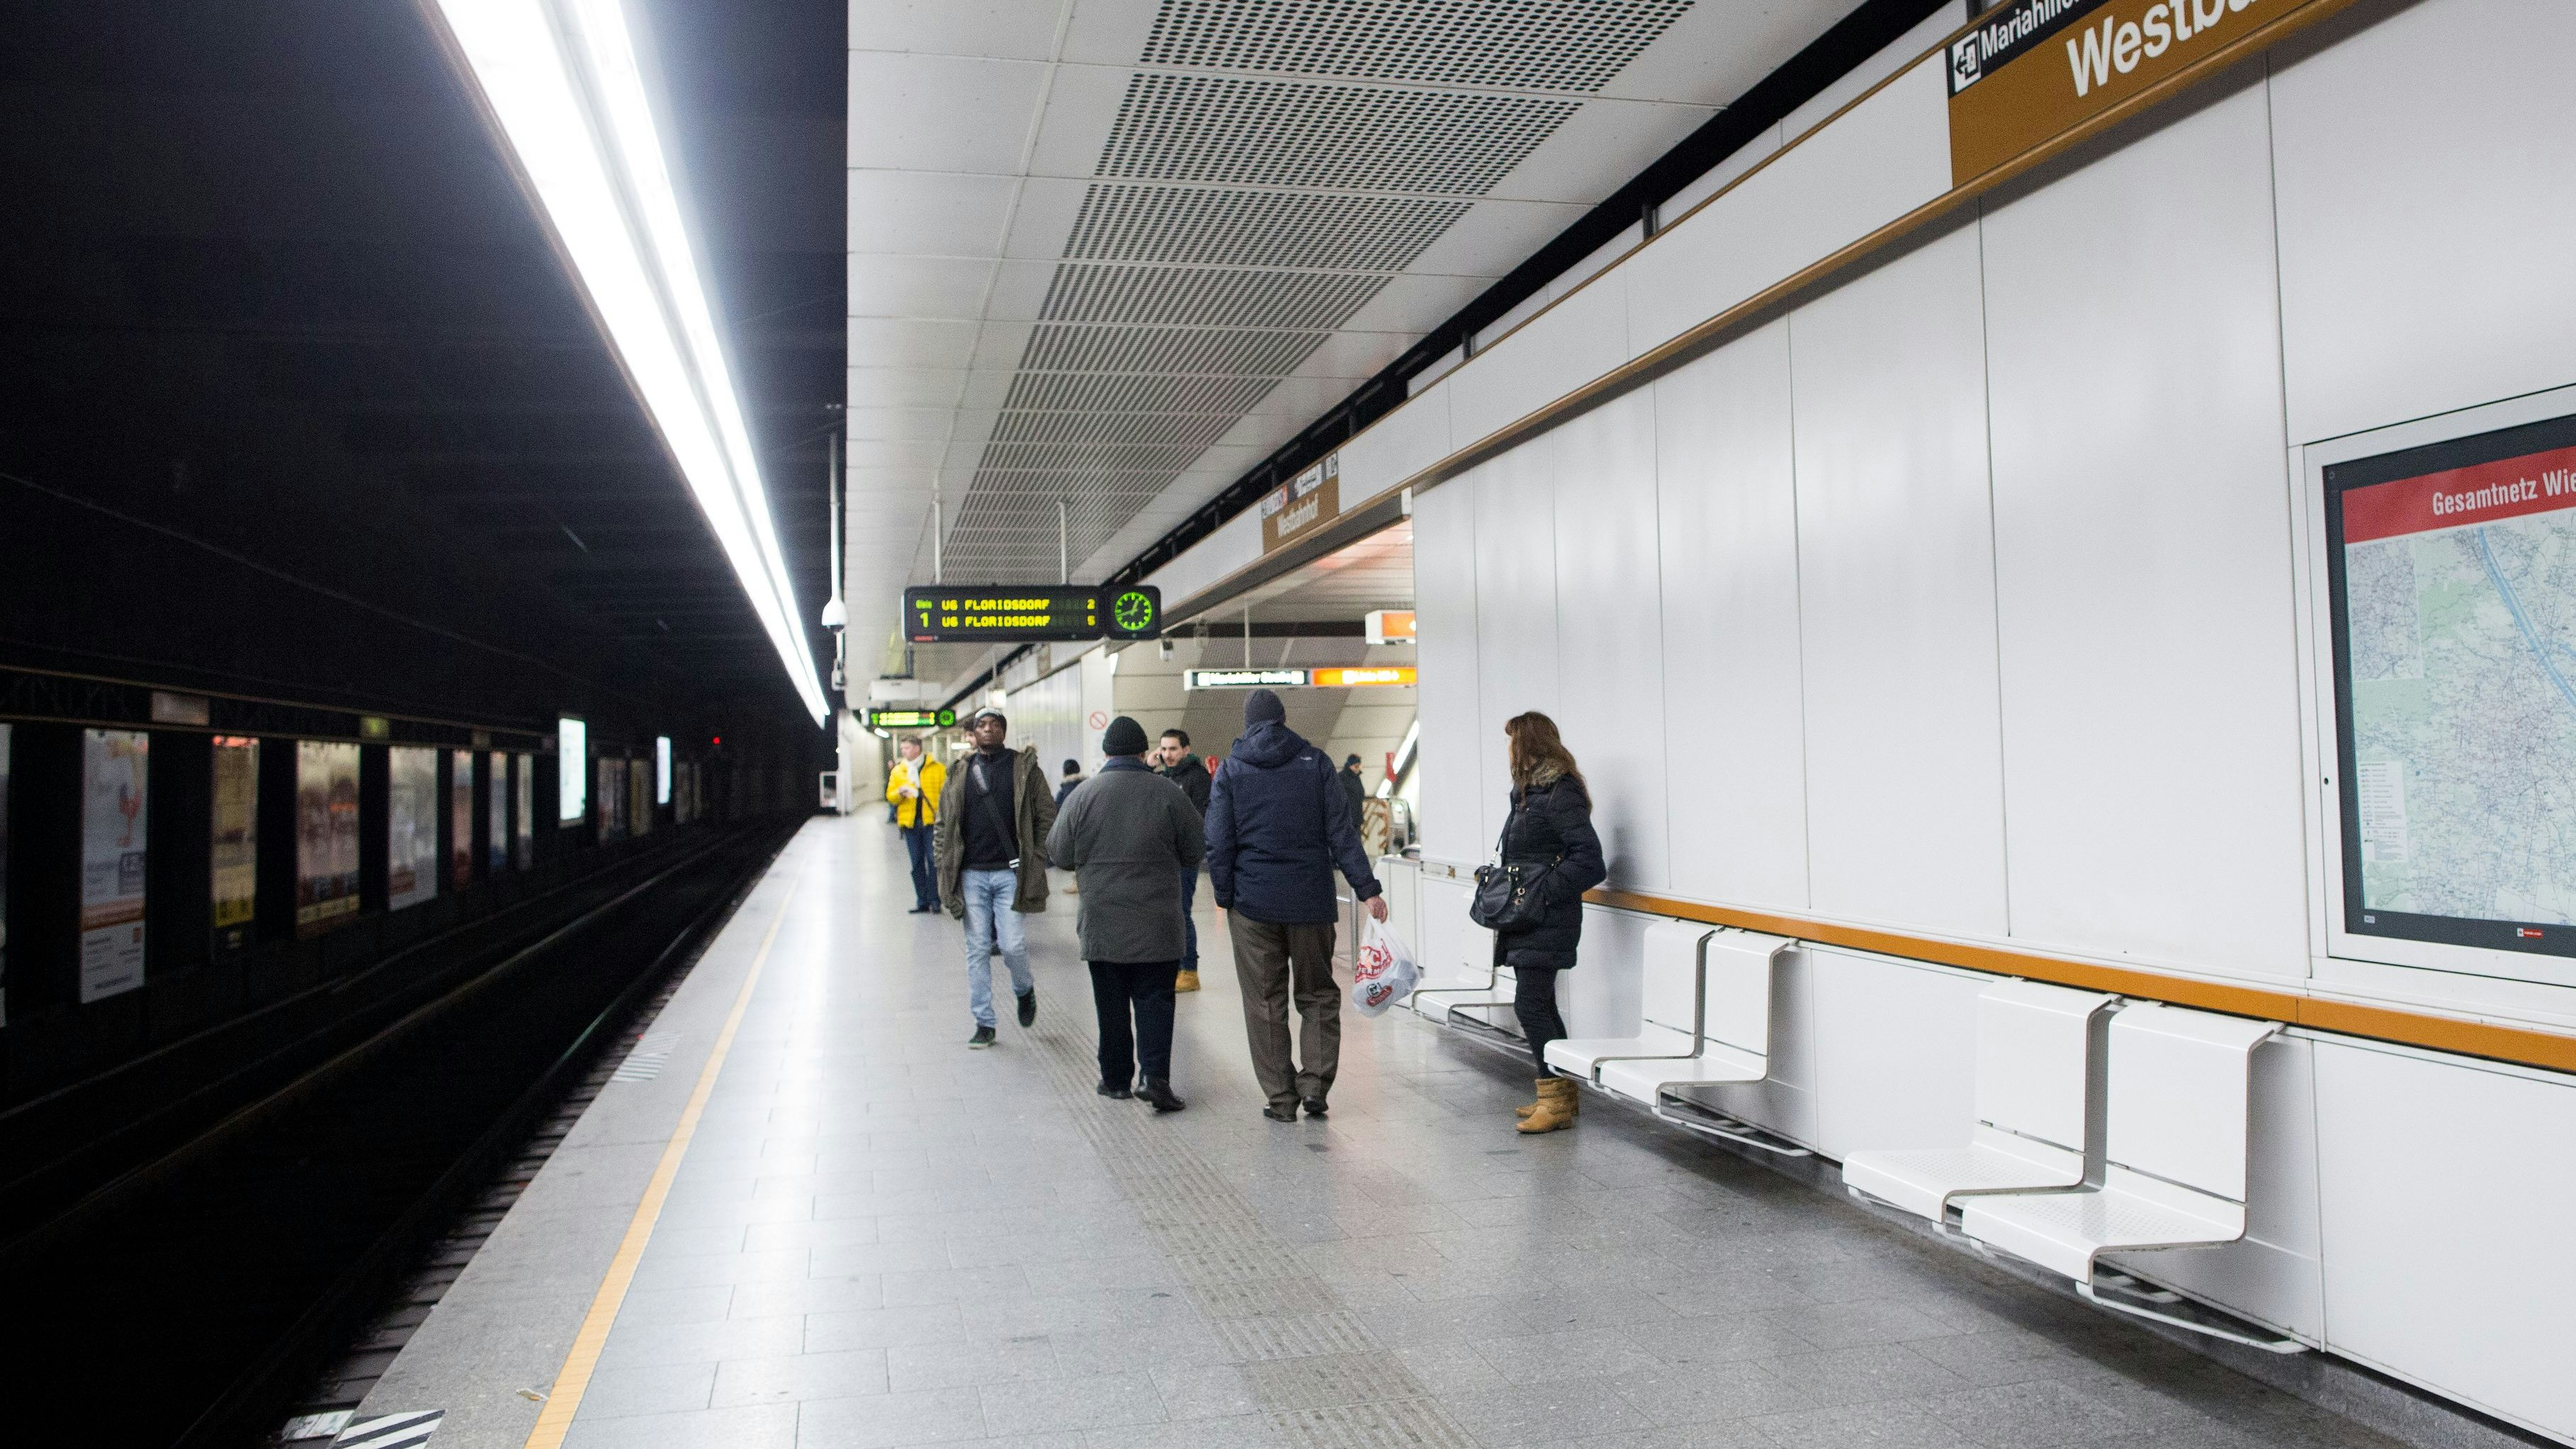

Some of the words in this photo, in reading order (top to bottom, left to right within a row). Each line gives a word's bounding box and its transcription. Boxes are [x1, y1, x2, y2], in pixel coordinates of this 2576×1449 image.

[2432, 477, 2538, 516] Gesamtnetz
[965, 599, 1050, 610] FLORIDSDORF
[1087, 599, 1095, 609] 2
[920, 612, 928, 628] 1
[965, 615, 1051, 627] FLORIDSDORF
